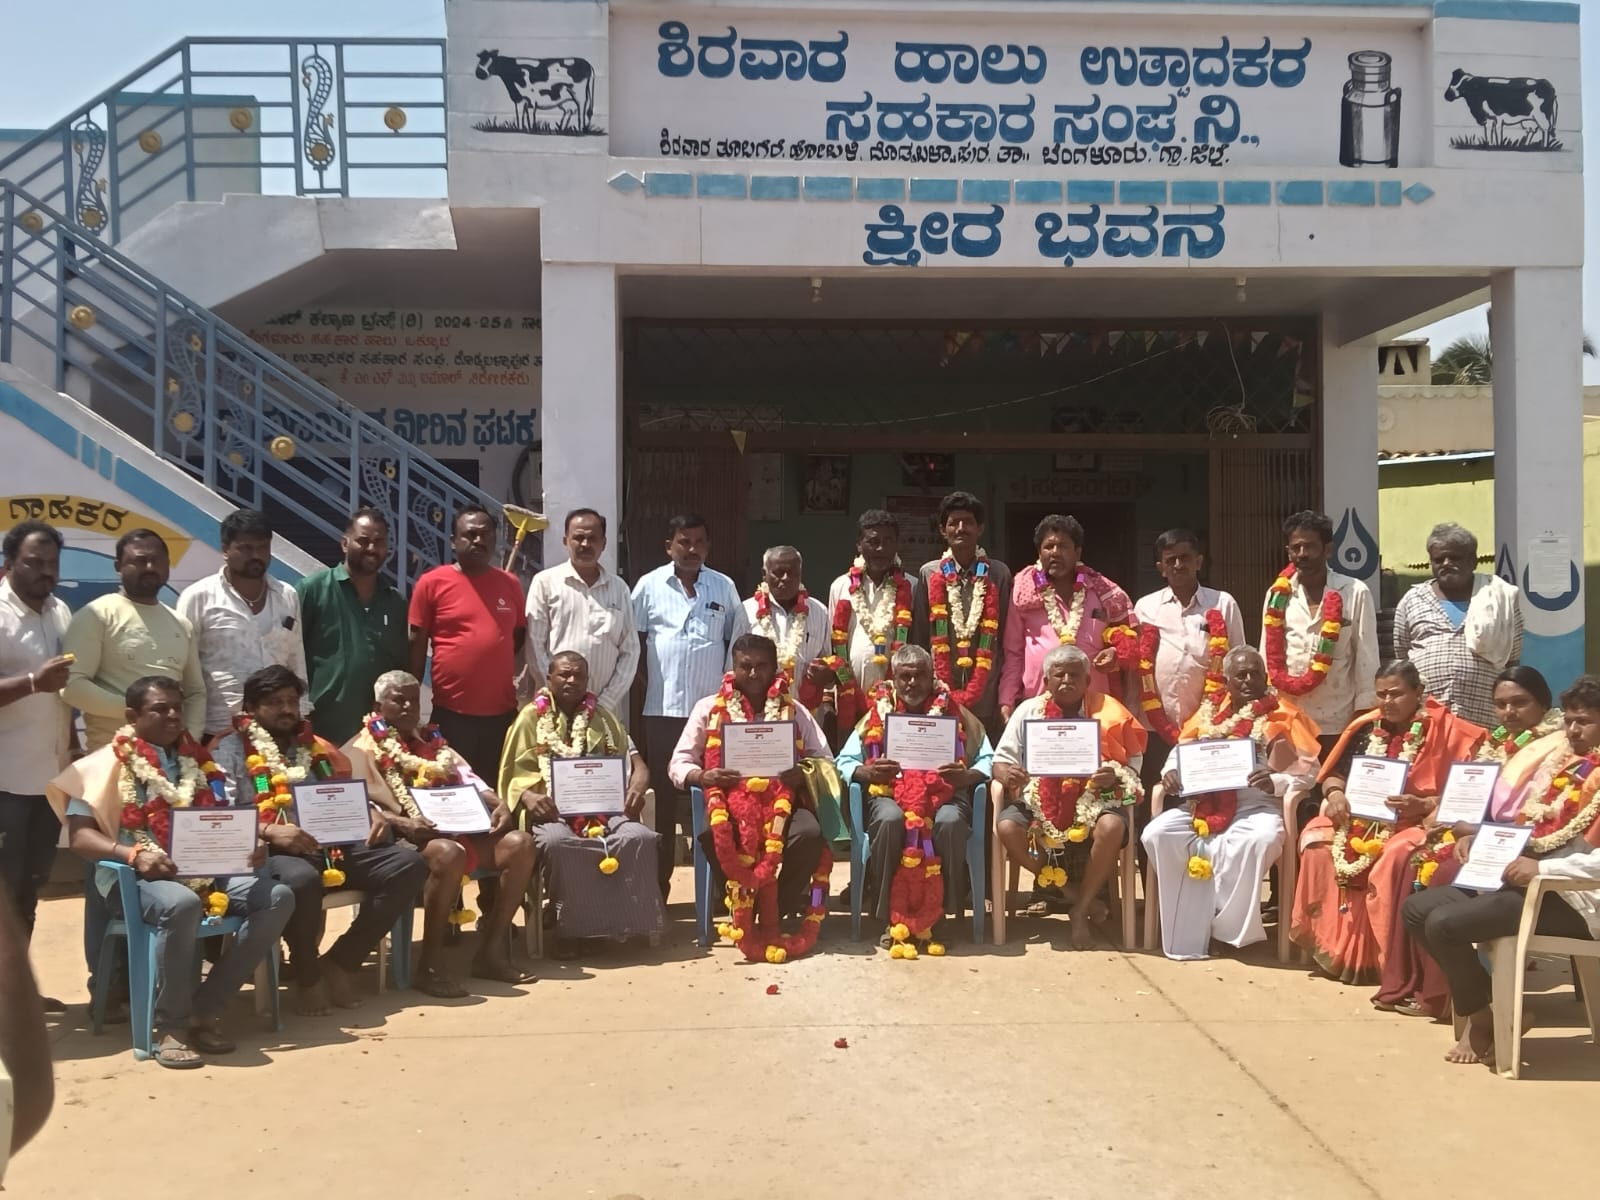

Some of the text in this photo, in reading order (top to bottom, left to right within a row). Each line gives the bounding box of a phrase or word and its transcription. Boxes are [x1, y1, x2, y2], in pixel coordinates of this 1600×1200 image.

[657, 20, 1312, 98] ಶಿರವಾರ ಹಾಲು ಉತ್ಪಾದಕರ
[659, 127, 712, 157] ಶಿರವಾರ
[825, 90, 1035, 144] ಸಹಕಾರ
[863, 203, 1226, 266] ಕ್ಷೀರ ಭವನ
[394, 408, 467, 446] ನೀರಿನ
[473, 408, 537, 452] ಘಟಕ
